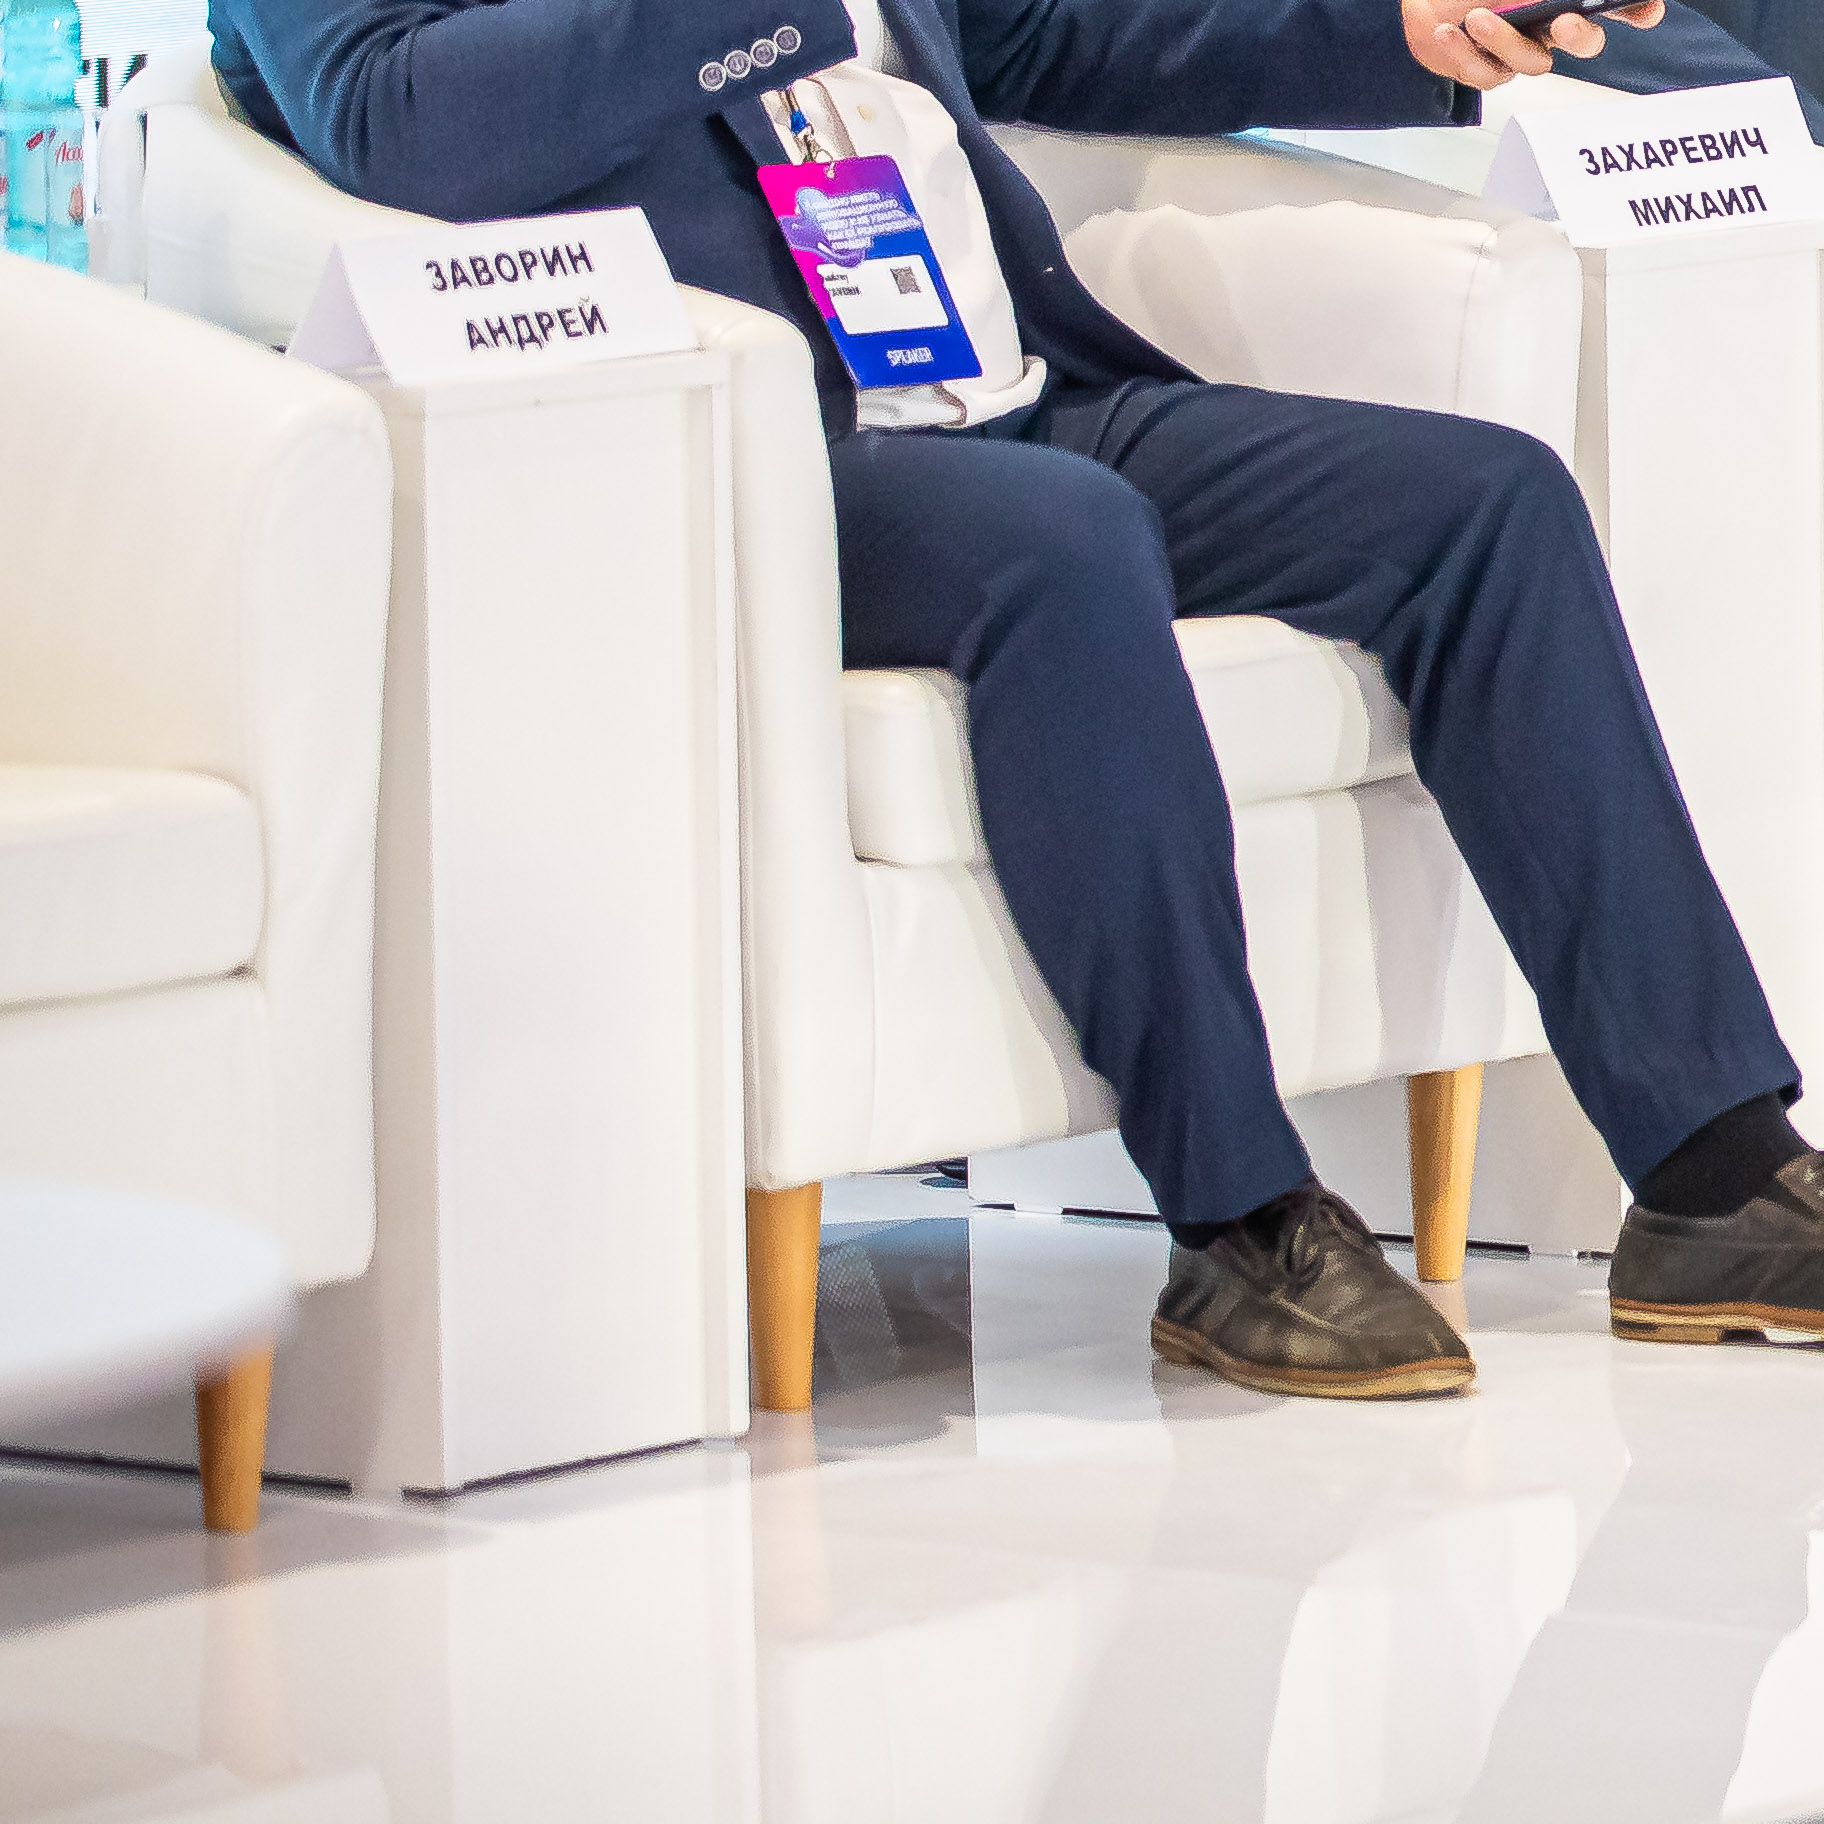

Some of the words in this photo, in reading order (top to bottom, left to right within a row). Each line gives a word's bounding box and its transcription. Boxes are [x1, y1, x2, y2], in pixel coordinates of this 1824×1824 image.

[1578, 126, 1769, 176] ЗАХАРЕВИЧ
[1628, 184, 1768, 228] МИХАИЛ
[424, 240, 595, 294] ЗАВОРИН
[465, 295, 609, 352] АНДРЕЙ
